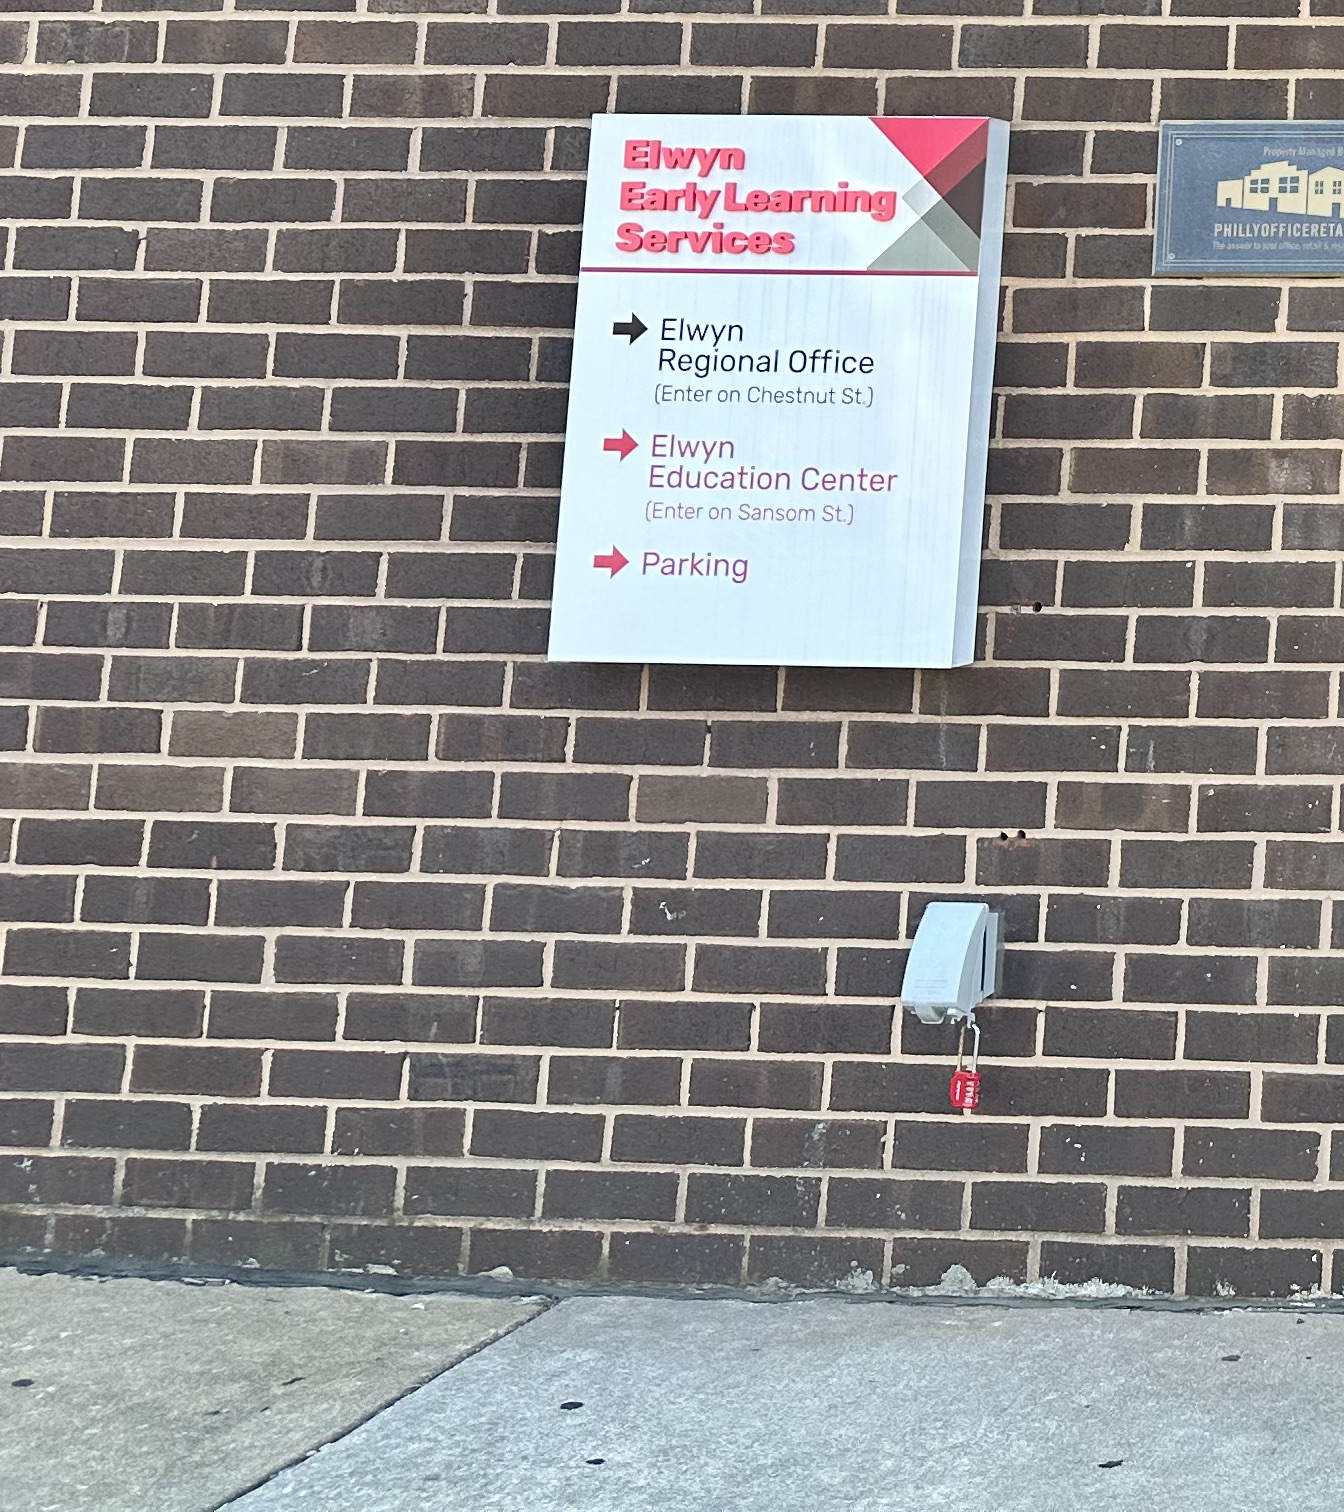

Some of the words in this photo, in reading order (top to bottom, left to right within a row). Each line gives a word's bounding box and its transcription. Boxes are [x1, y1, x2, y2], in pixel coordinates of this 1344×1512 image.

[622, 139, 746, 178] Elwyn
[619, 181, 721, 219] Early
[723, 181, 897, 222] Learning
[615, 222, 796, 256] Services
[660, 317, 744, 349] Elwyn
[658, 348, 780, 378] Regional
[788, 349, 875, 375] Office
[654, 383, 711, 407] (Enter
[716, 389, 741, 404] on
[747, 386, 837, 406] Chestnut
[841, 386, 874, 408] St.)
[650, 433, 735, 465] Elwyn
[648, 464, 791, 492] Education
[800, 466, 899, 493] Center
[645, 500, 702, 523] (Enter
[708, 504, 732, 521] on
[738, 503, 816, 522] Sansom
[821, 502, 854, 525] St.)
[641, 550, 749, 584] Parking
